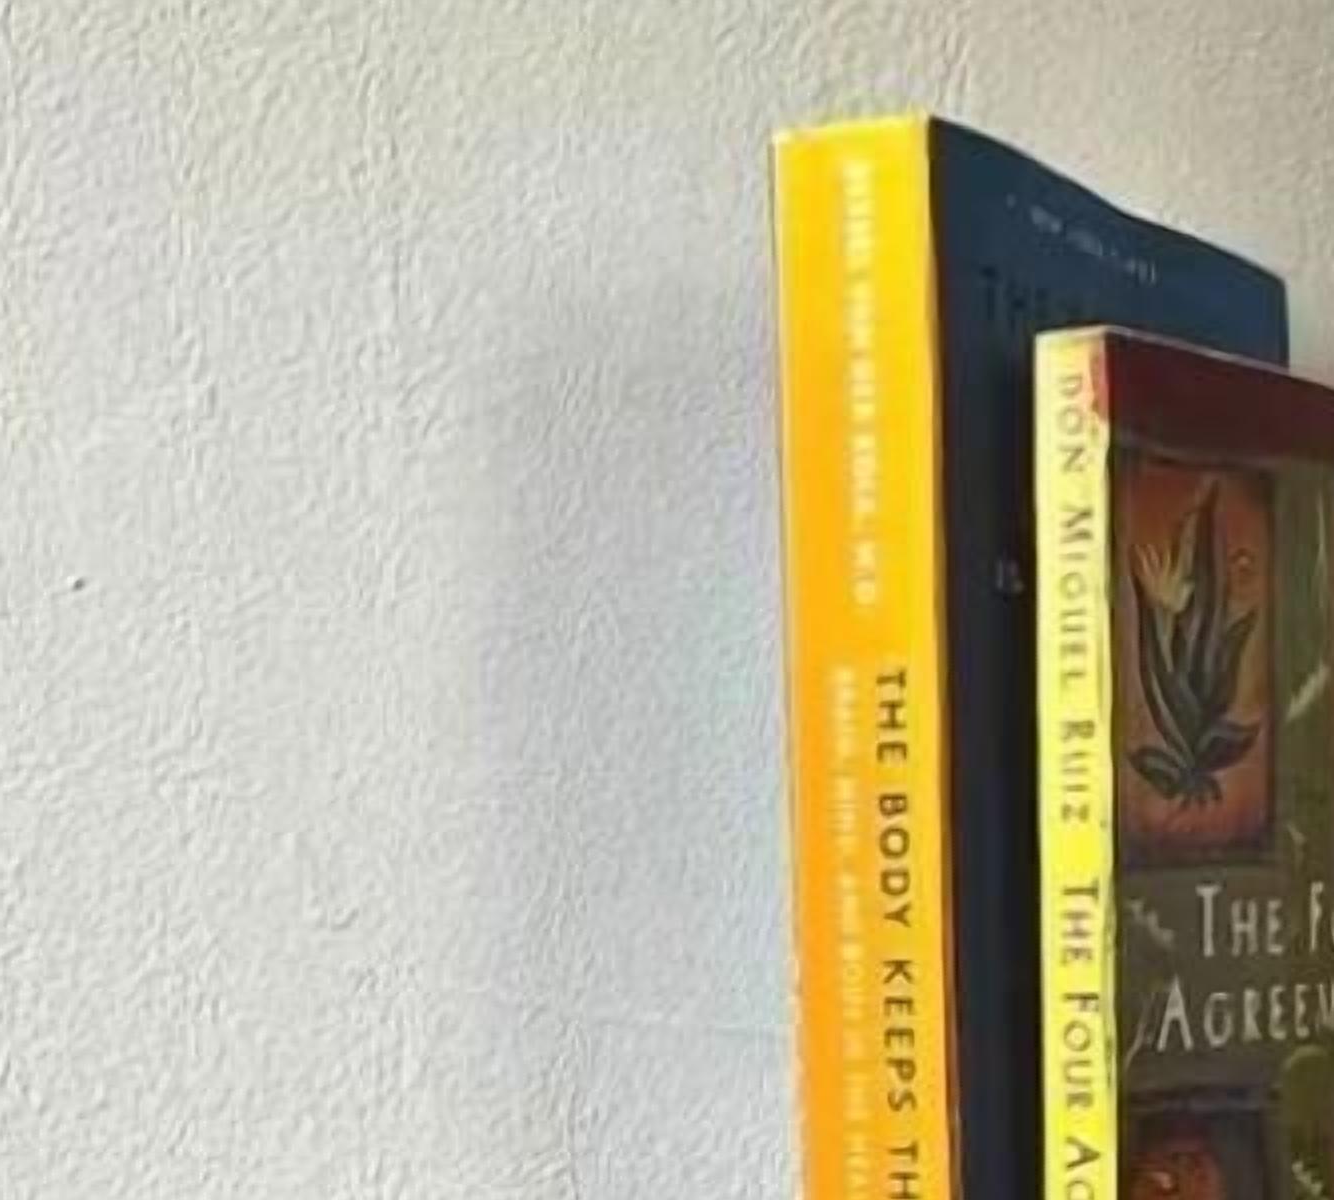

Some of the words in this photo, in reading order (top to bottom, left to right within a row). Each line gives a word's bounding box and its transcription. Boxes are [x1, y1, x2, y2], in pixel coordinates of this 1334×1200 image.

[1056, 373, 1087, 475] DON
[1058, 508, 1094, 691] MIGUEL
[876, 670, 907, 764] THE
[1060, 718, 1097, 823] RUIZ
[878, 791, 911, 929] BODY
[1061, 878, 1100, 967] THE
[1195, 883, 1284, 957] THE
[882, 958, 915, 1113] KEEPS
[1062, 992, 1101, 1111] FOUR
